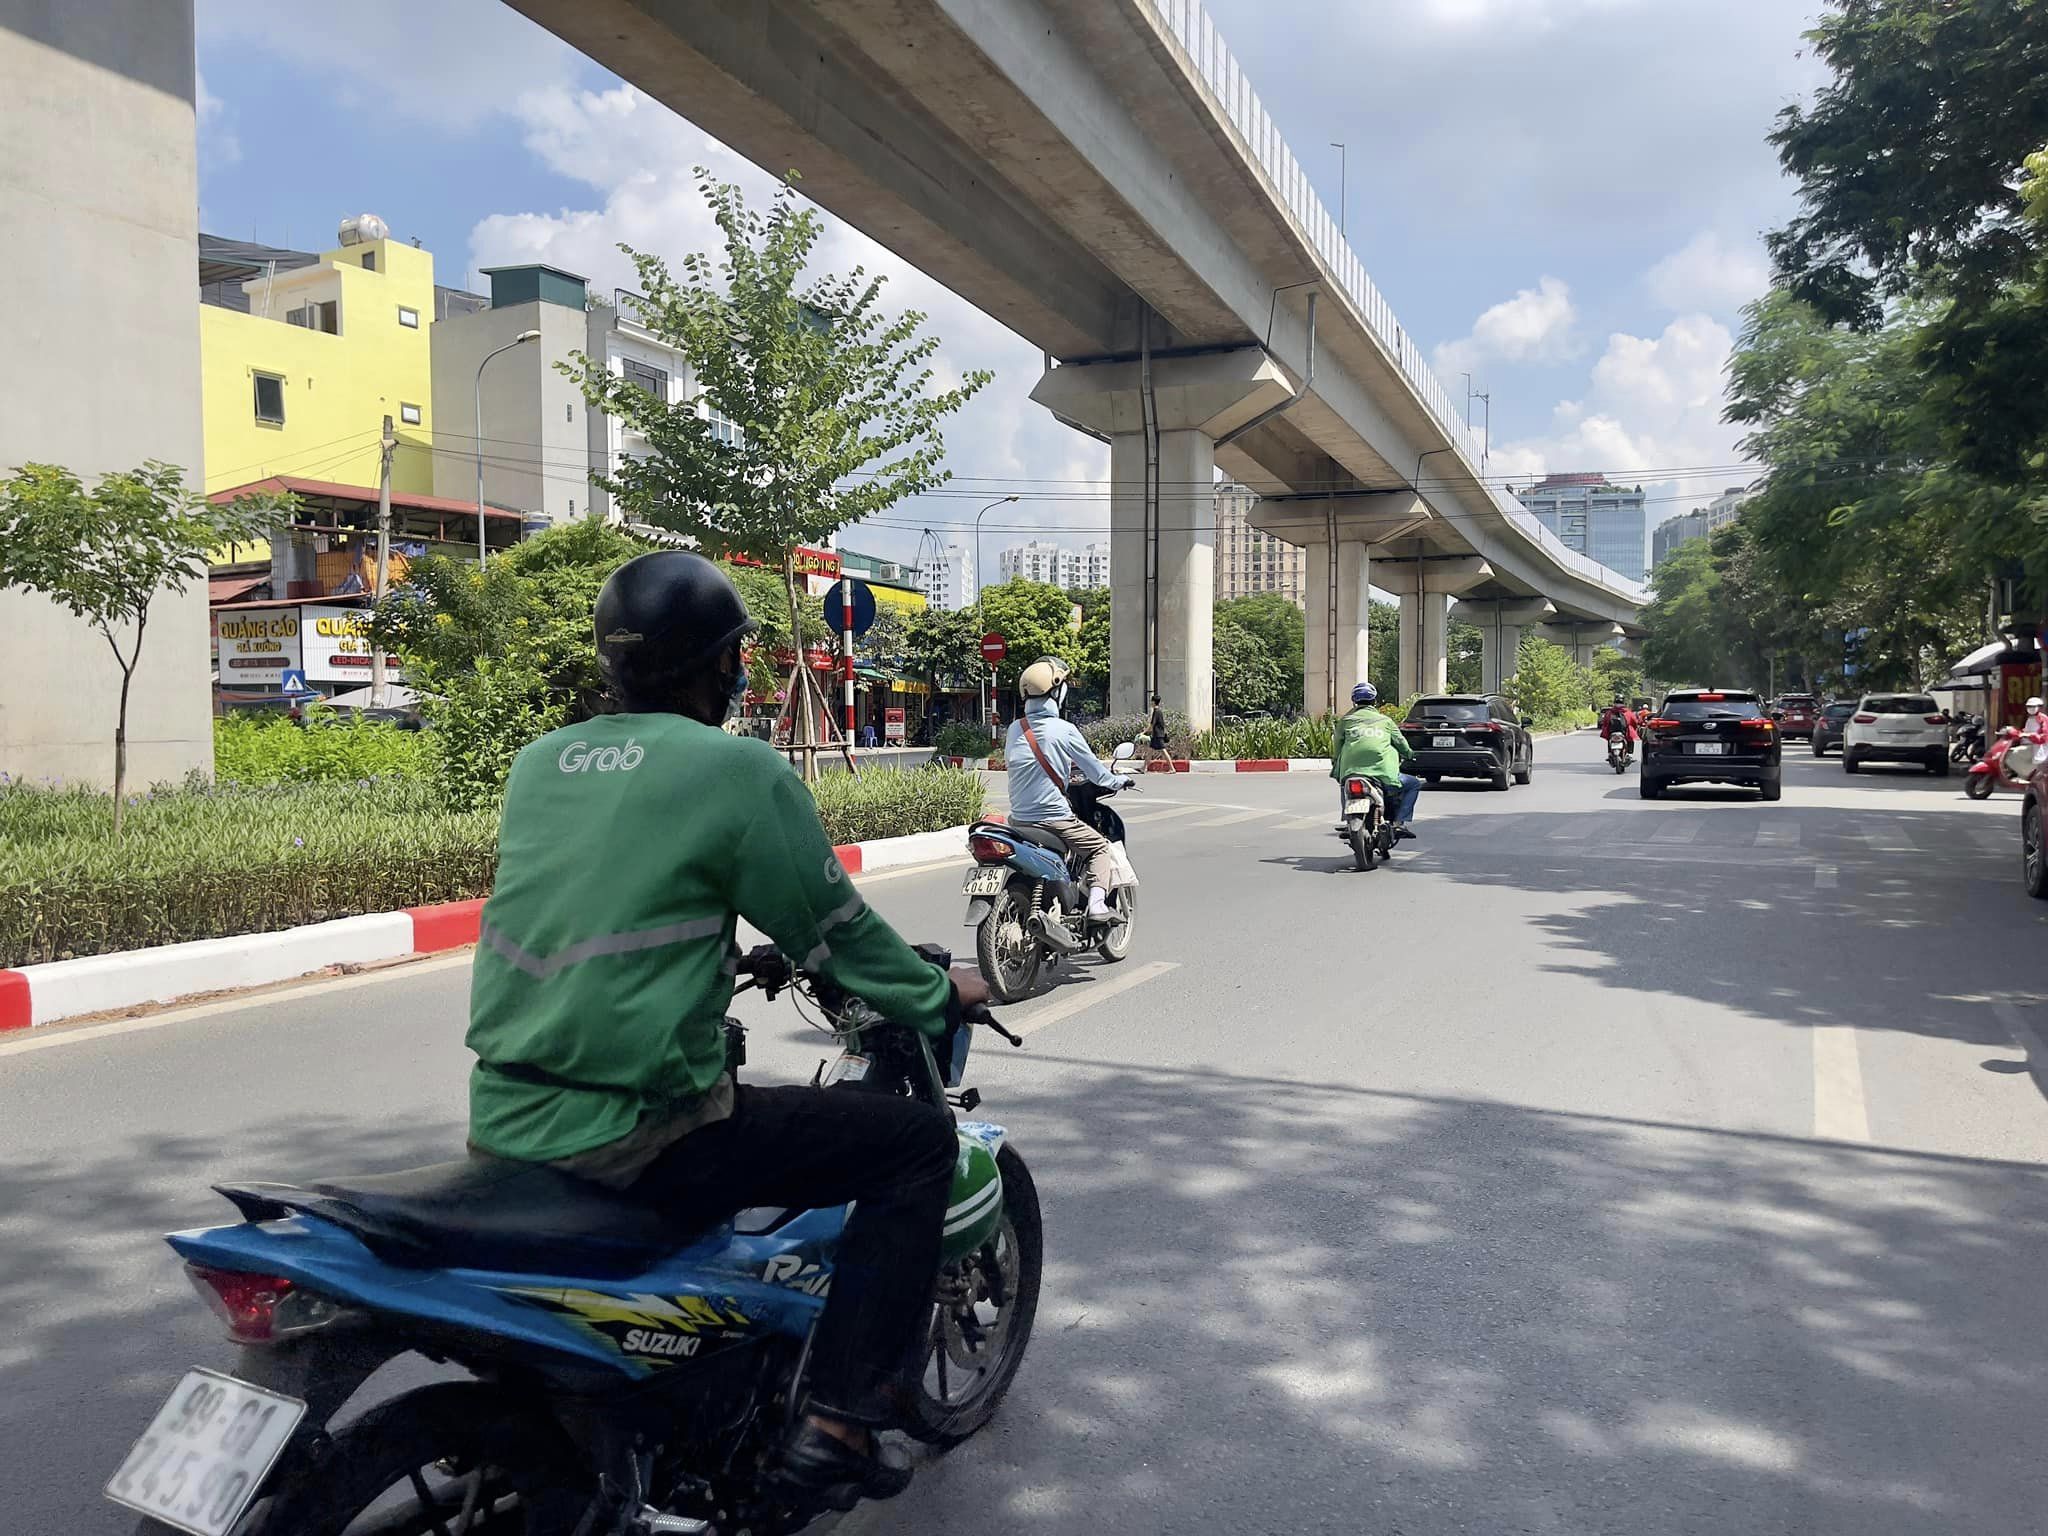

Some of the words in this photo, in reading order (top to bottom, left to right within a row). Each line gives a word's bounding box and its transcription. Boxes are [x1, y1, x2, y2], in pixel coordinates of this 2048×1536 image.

[219, 615, 268, 639] QUẢNG
[270, 614, 298, 637] CÁO
[558, 738, 645, 773] Grab
[622, 1329, 701, 1356] SUZUKI
